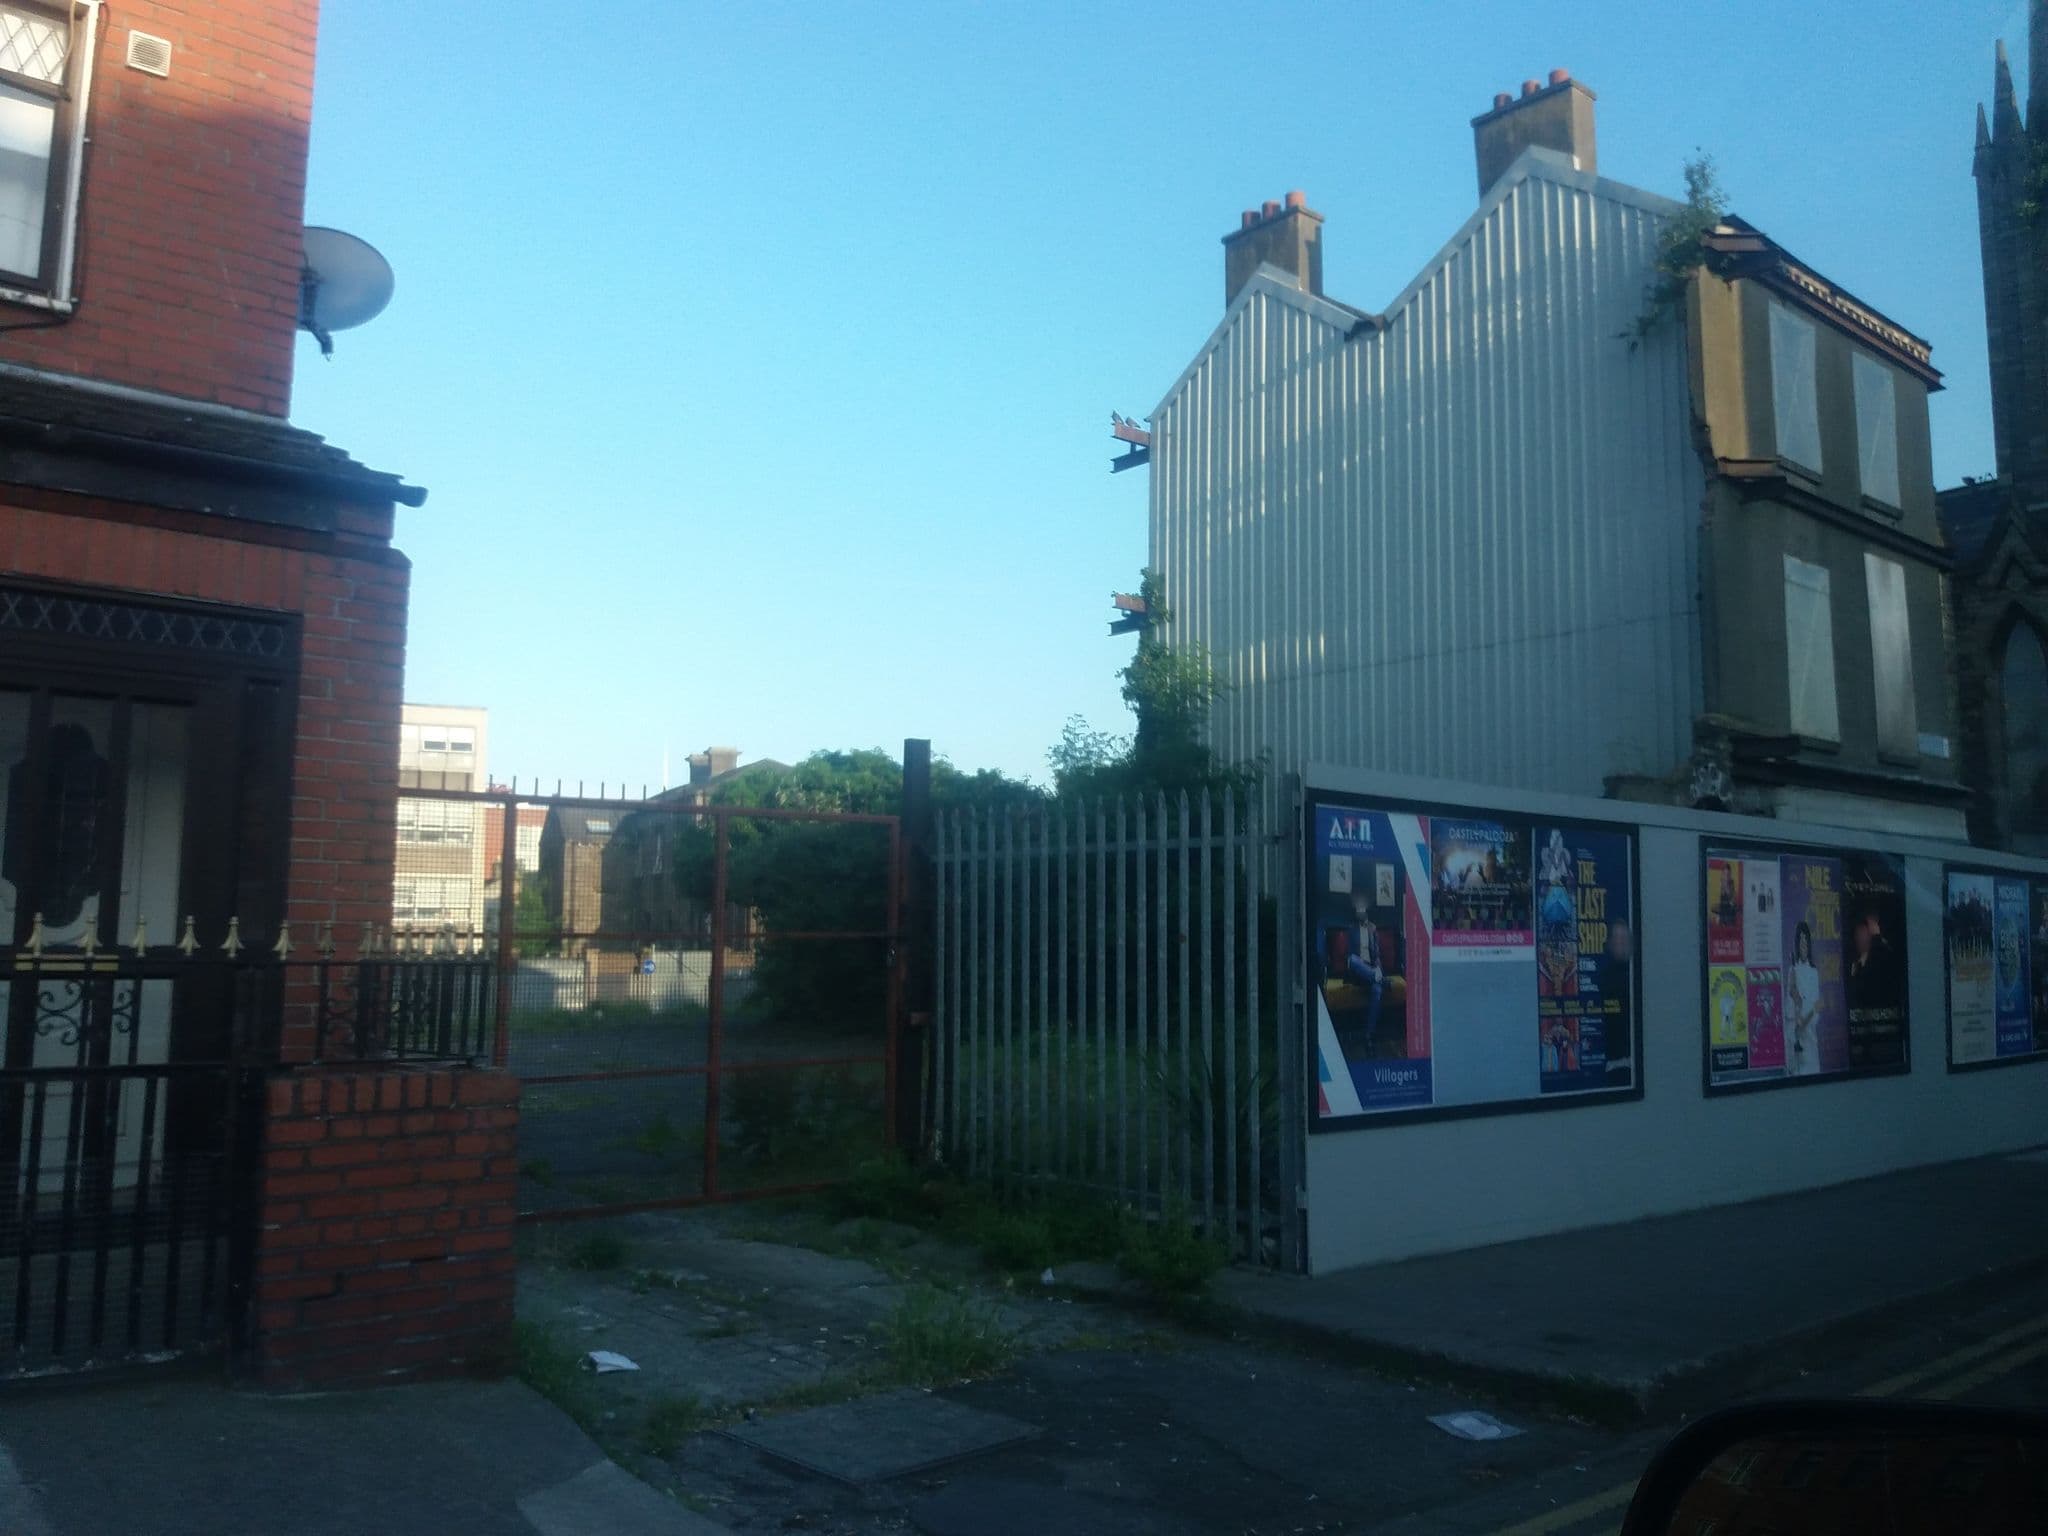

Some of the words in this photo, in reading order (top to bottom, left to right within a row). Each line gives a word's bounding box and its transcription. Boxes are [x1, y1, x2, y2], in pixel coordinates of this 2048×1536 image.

[1577, 860, 1597, 885] THE
[1578, 887, 1606, 920] LAST
[1579, 920, 1608, 955] SHIP
[1374, 1067, 1418, 1086] Villagers
